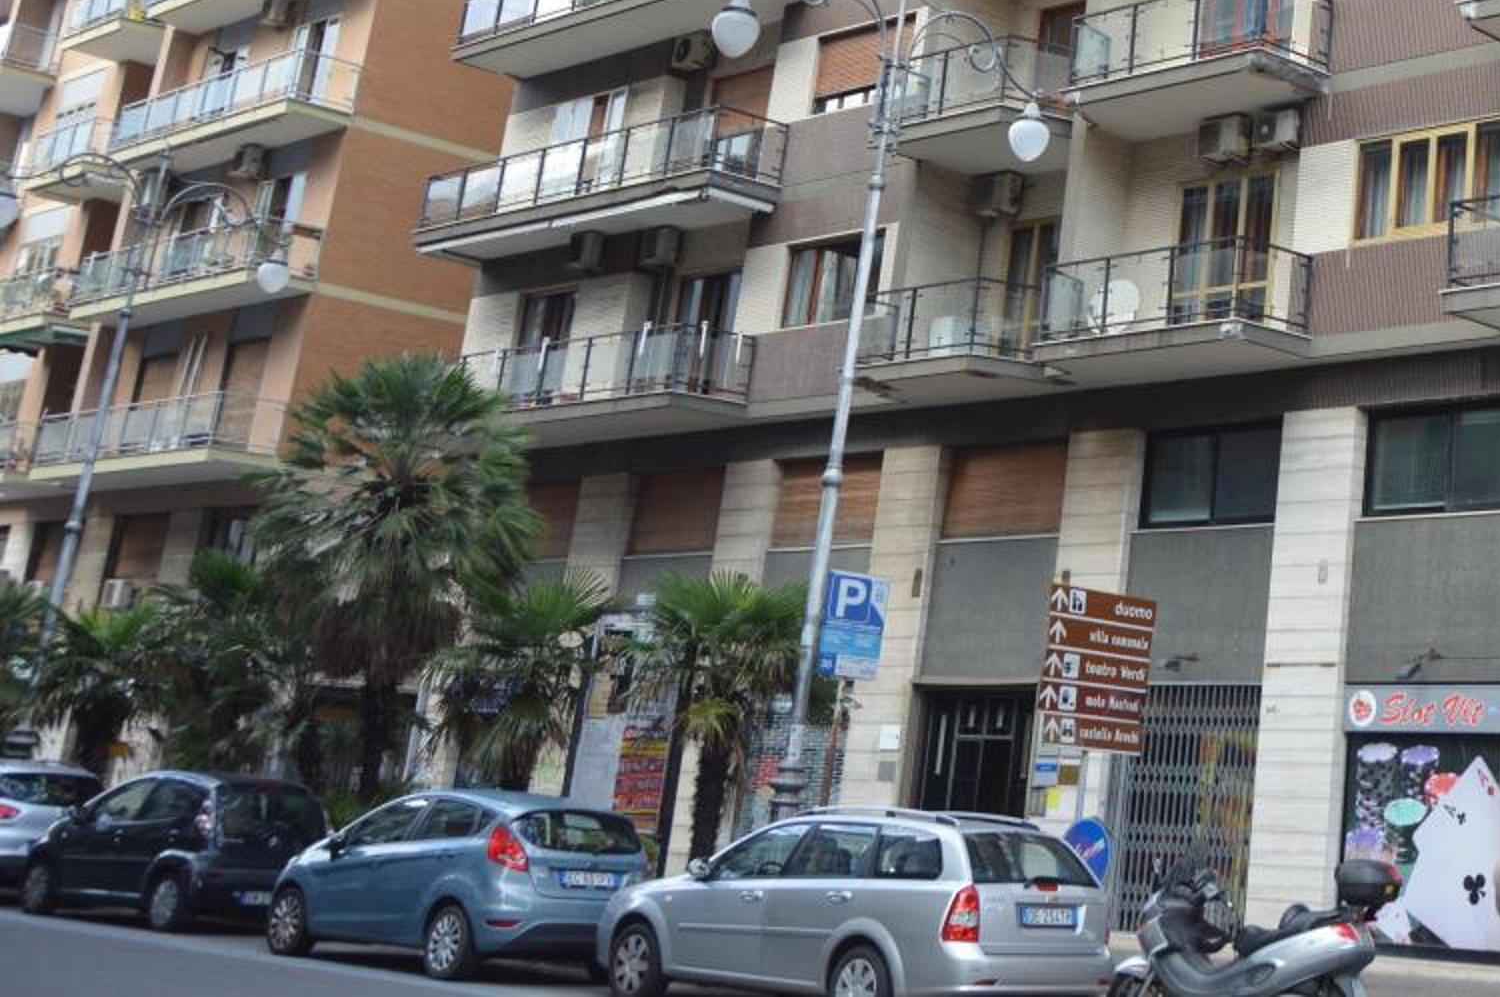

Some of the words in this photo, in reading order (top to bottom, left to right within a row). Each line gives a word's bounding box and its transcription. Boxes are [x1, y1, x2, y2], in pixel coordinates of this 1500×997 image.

[836, 578, 867, 618] P
[1114, 601, 1153, 620] duomo
[1085, 660, 1117, 678] teatro
[1380, 691, 1436, 725] Slot
